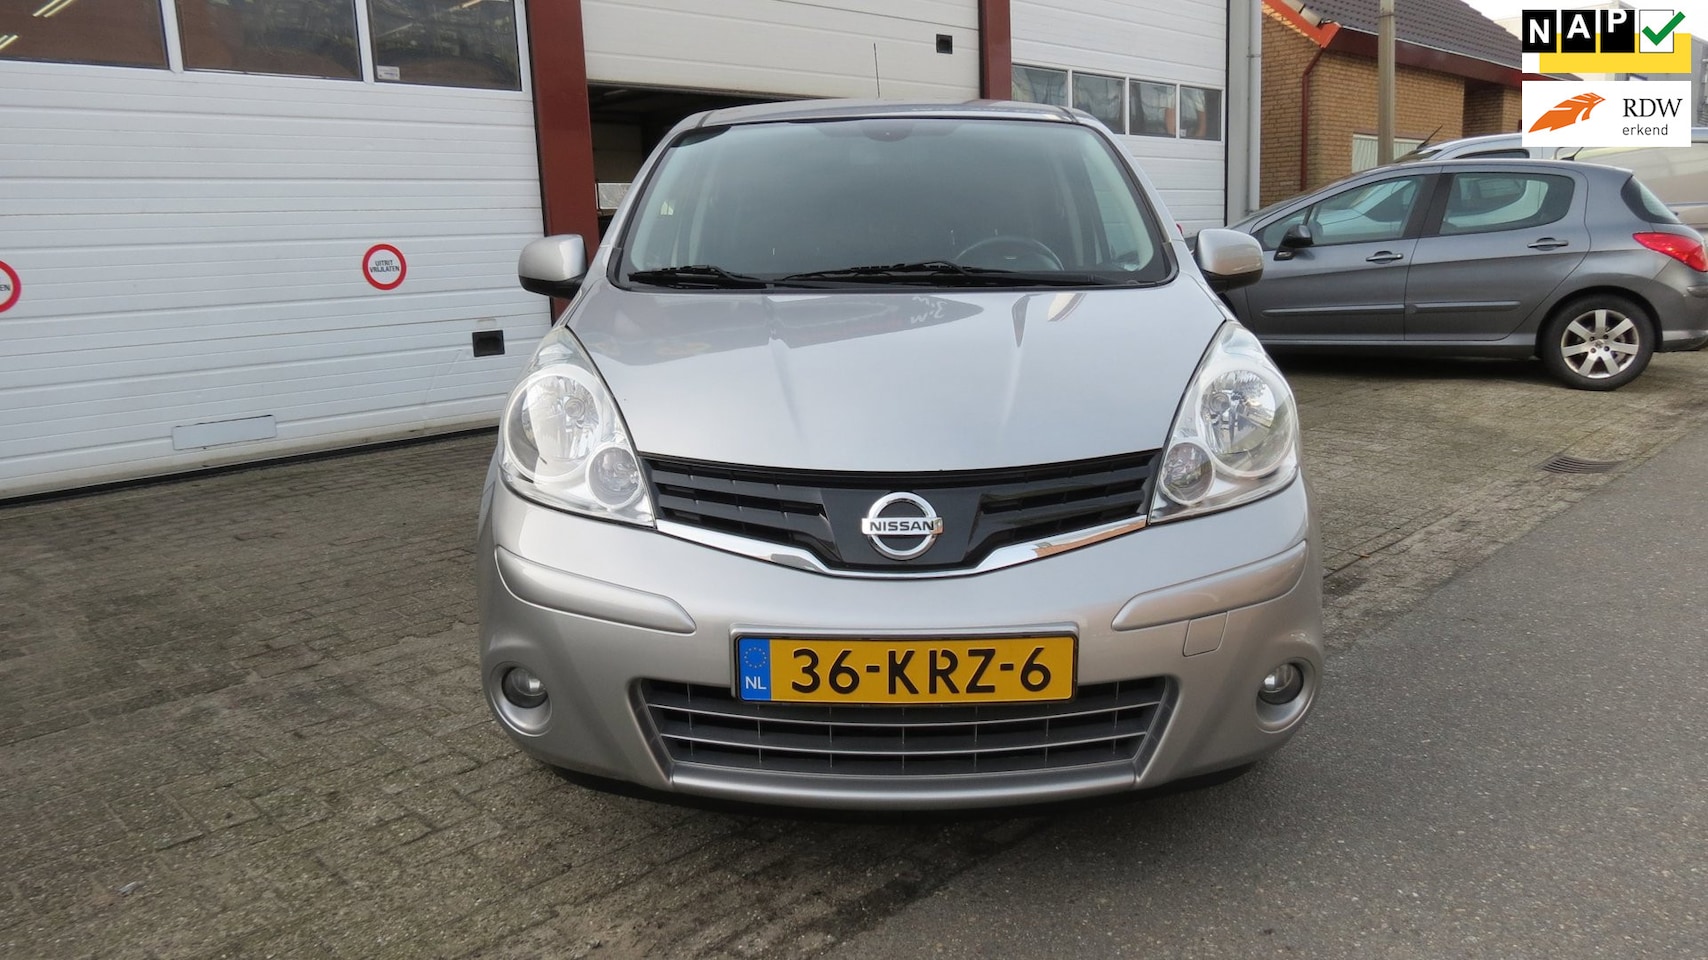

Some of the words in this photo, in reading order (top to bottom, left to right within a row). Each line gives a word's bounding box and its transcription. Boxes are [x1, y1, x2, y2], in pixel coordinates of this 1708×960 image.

[870, 521, 934, 531] NISSAN
[791, 647, 1051, 694] 36-KRZ-6
[745, 676, 766, 690] NL
